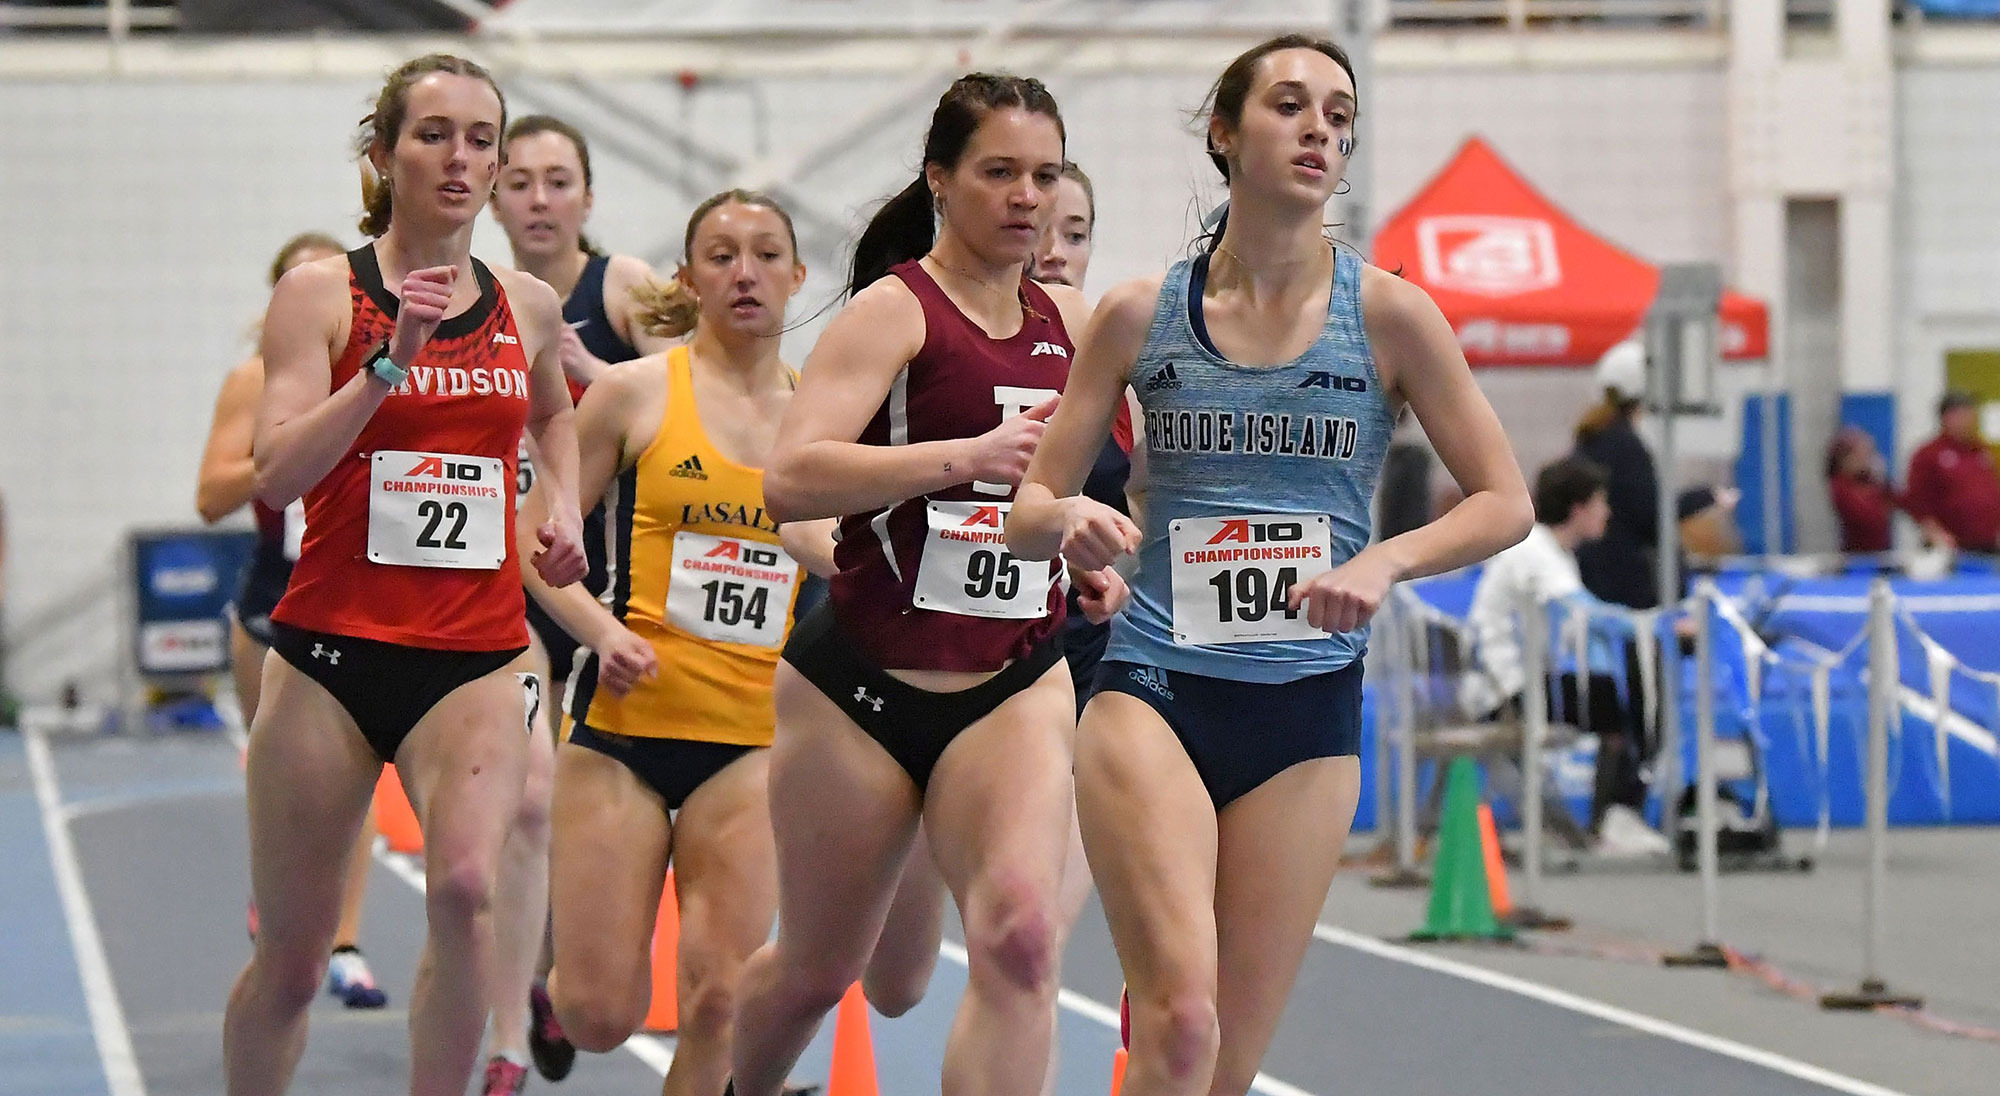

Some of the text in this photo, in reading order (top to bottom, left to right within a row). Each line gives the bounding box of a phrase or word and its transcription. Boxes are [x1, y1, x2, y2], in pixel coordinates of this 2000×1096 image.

[493, 333, 518, 345] A10
[1030, 341, 1068, 359] A10
[1147, 380, 1183, 391] adidas
[1298, 371, 1367, 393] A10
[1149, 411, 1359, 461] RHODE ISLAND
[403, 455, 482, 482] A10
[383, 480, 499, 499] CHAMPIONSHIPS
[416, 500, 469, 550] 22
[939, 528, 1005, 545] CHAMPIO
[1204, 519, 1304, 546] A10
[704, 540, 778, 567] A10
[1183, 545, 1323, 565] CHAMPIONSHIPS
[682, 558, 790, 585] CHAMPIONSHIPS
[964, 549, 1021, 601] 95
[701, 579, 769, 630] 154
[1208, 566, 1302, 623] 194
[1128, 670, 1175, 701] adidas
